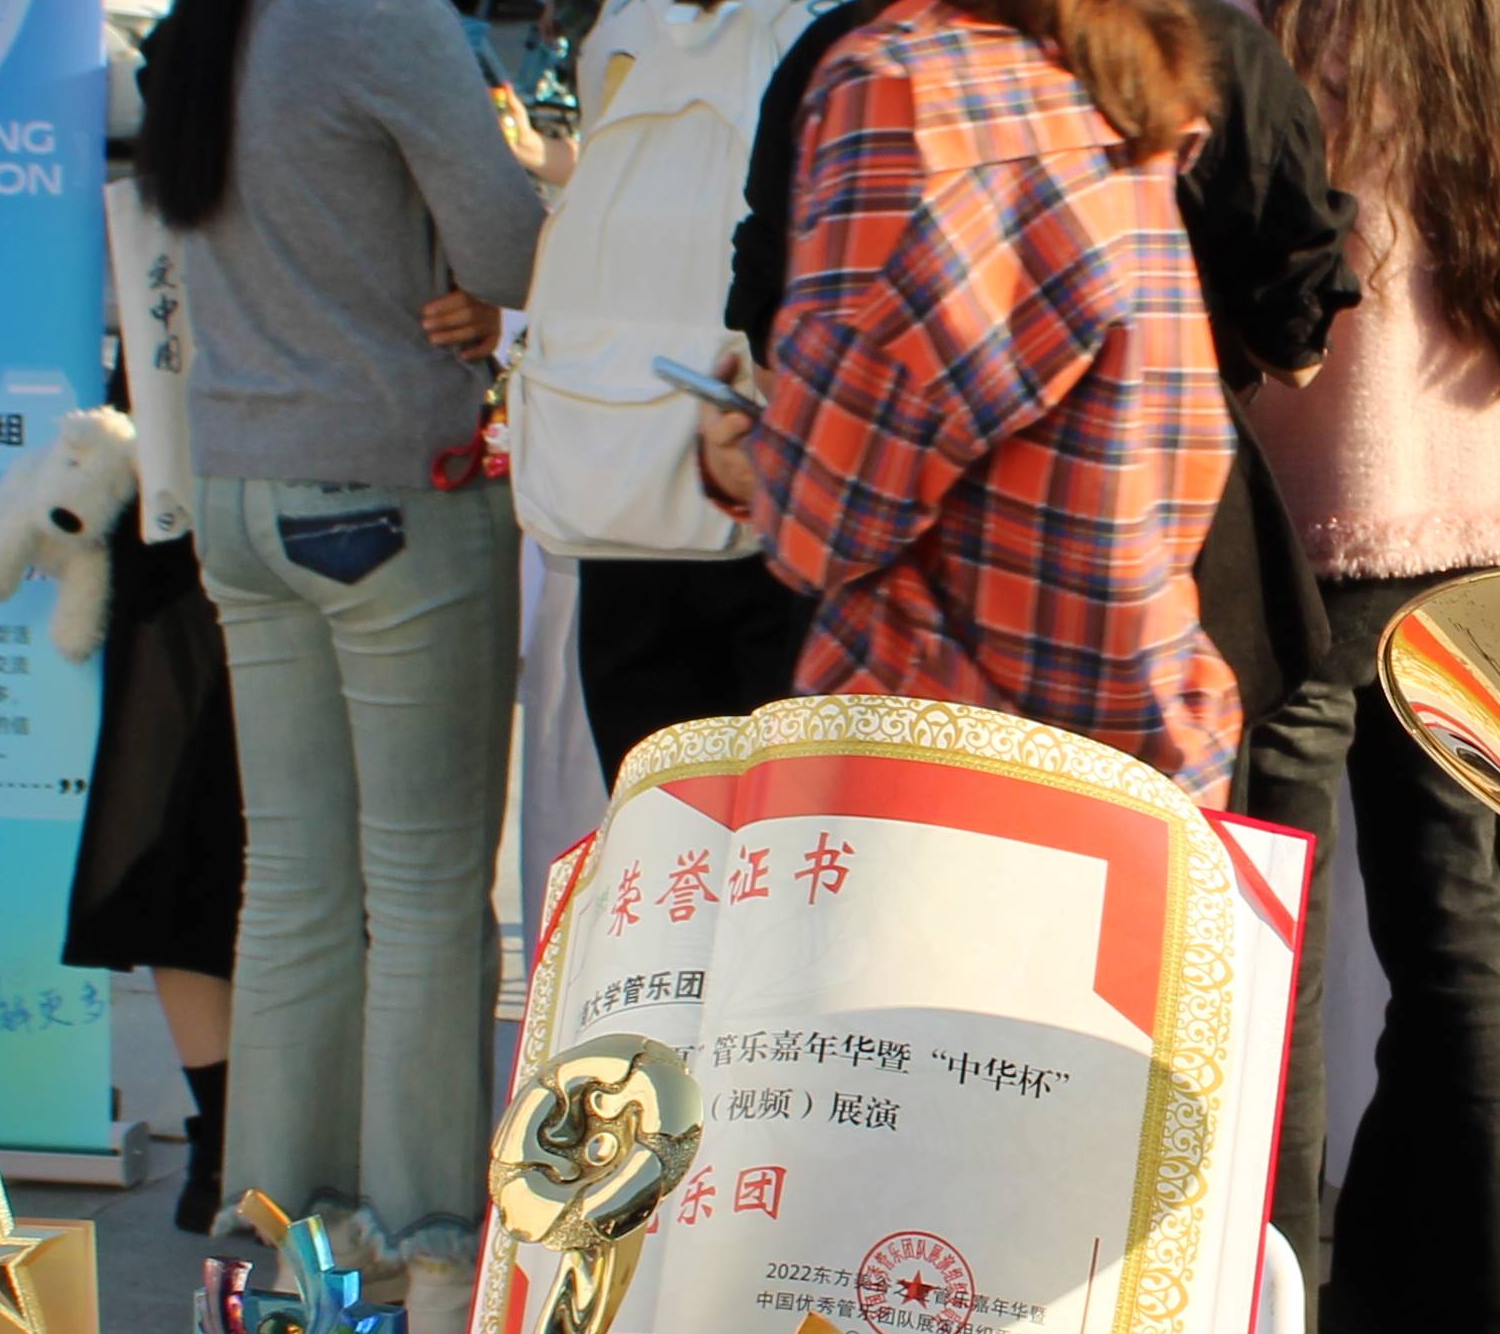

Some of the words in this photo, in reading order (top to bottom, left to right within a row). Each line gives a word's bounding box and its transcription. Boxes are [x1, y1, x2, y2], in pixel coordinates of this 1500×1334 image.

[607, 831, 856, 938] 荣誉证书
[646, 1165, 787, 1234] 乐团
